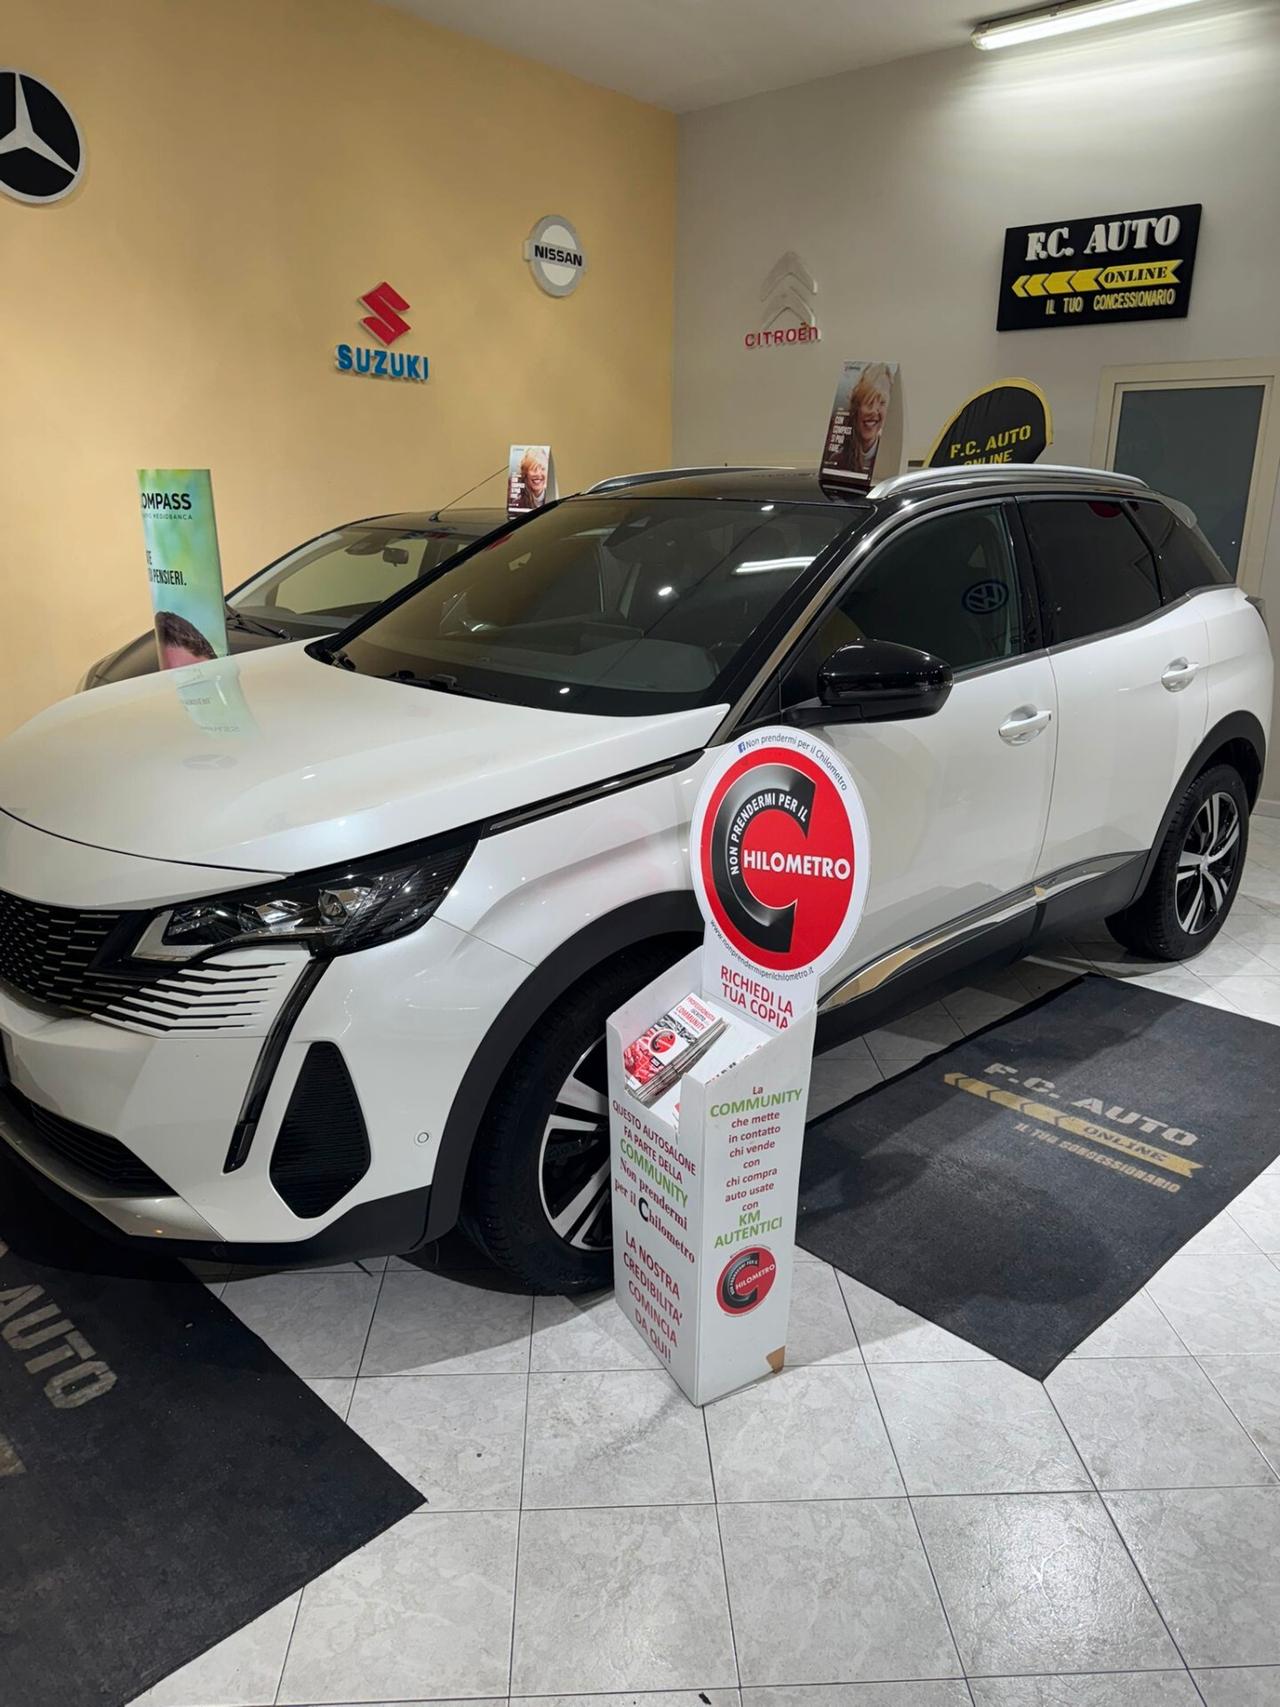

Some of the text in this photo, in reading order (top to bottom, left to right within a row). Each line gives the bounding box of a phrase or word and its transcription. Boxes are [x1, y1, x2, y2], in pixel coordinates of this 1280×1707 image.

[534, 244, 583, 267] NISSAN
[1025, 214, 1181, 261] F.C. AUTO
[1103, 266, 1168, 284] ONLINE
[1045, 288, 1177, 315] IL TUO CONCESSIONARIO
[336, 344, 430, 382] SUZUKI
[949, 425, 1031, 459] F.C. AUTO
[142, 492, 192, 511] OMPASS
[153, 569, 187, 586] PENSIERI.
[746, 733, 848, 791] Non prendermi per il Chilometro
[729, 792, 810, 876] NON PRENDERMI PER IL
[720, 965, 794, 1018] RICHIEDI LA
[722, 983, 789, 1030] TUA COPIA
[709, 1088, 803, 1118] COMMUNITY
[752, 1085, 764, 1096] La
[984, 1062, 1199, 1147] F.C. AUTO
[728, 1124, 781, 1144] in contatto
[731, 1110, 780, 1128] che mette
[612, 1100, 696, 1177] QUESTO AUTOSALONE
[623, 1125, 684, 1185] FA PARTE DELLA
[729, 1140, 776, 1159] chi vende
[1083, 1125, 1168, 1162] ONLINE
[619, 1138, 689, 1208] COMMUNITY
[743, 1157, 761, 1169] con
[1013, 1122, 1030, 1133] IL
[1058, 1136, 1181, 1193] CONCESSIONARIO
[619, 1156, 688, 1231] Non prendermi
[724, 1181, 775, 1203] auto usate
[725, 1167, 778, 1188] chi compra
[614, 1177, 696, 1264] per il Chilometro
[739, 1210, 761, 1227] KM
[741, 1200, 759, 1212] con
[713, 1217, 783, 1249] AUTENTICI
[624, 1229, 681, 1301] LA NOSTRA
[623, 1251, 684, 1326] CREDIBILITA'
[628, 1279, 678, 1348] COMINCIA
[0, 1284, 118, 1409] AUTO
[634, 1309, 672, 1363] DA QUI!
